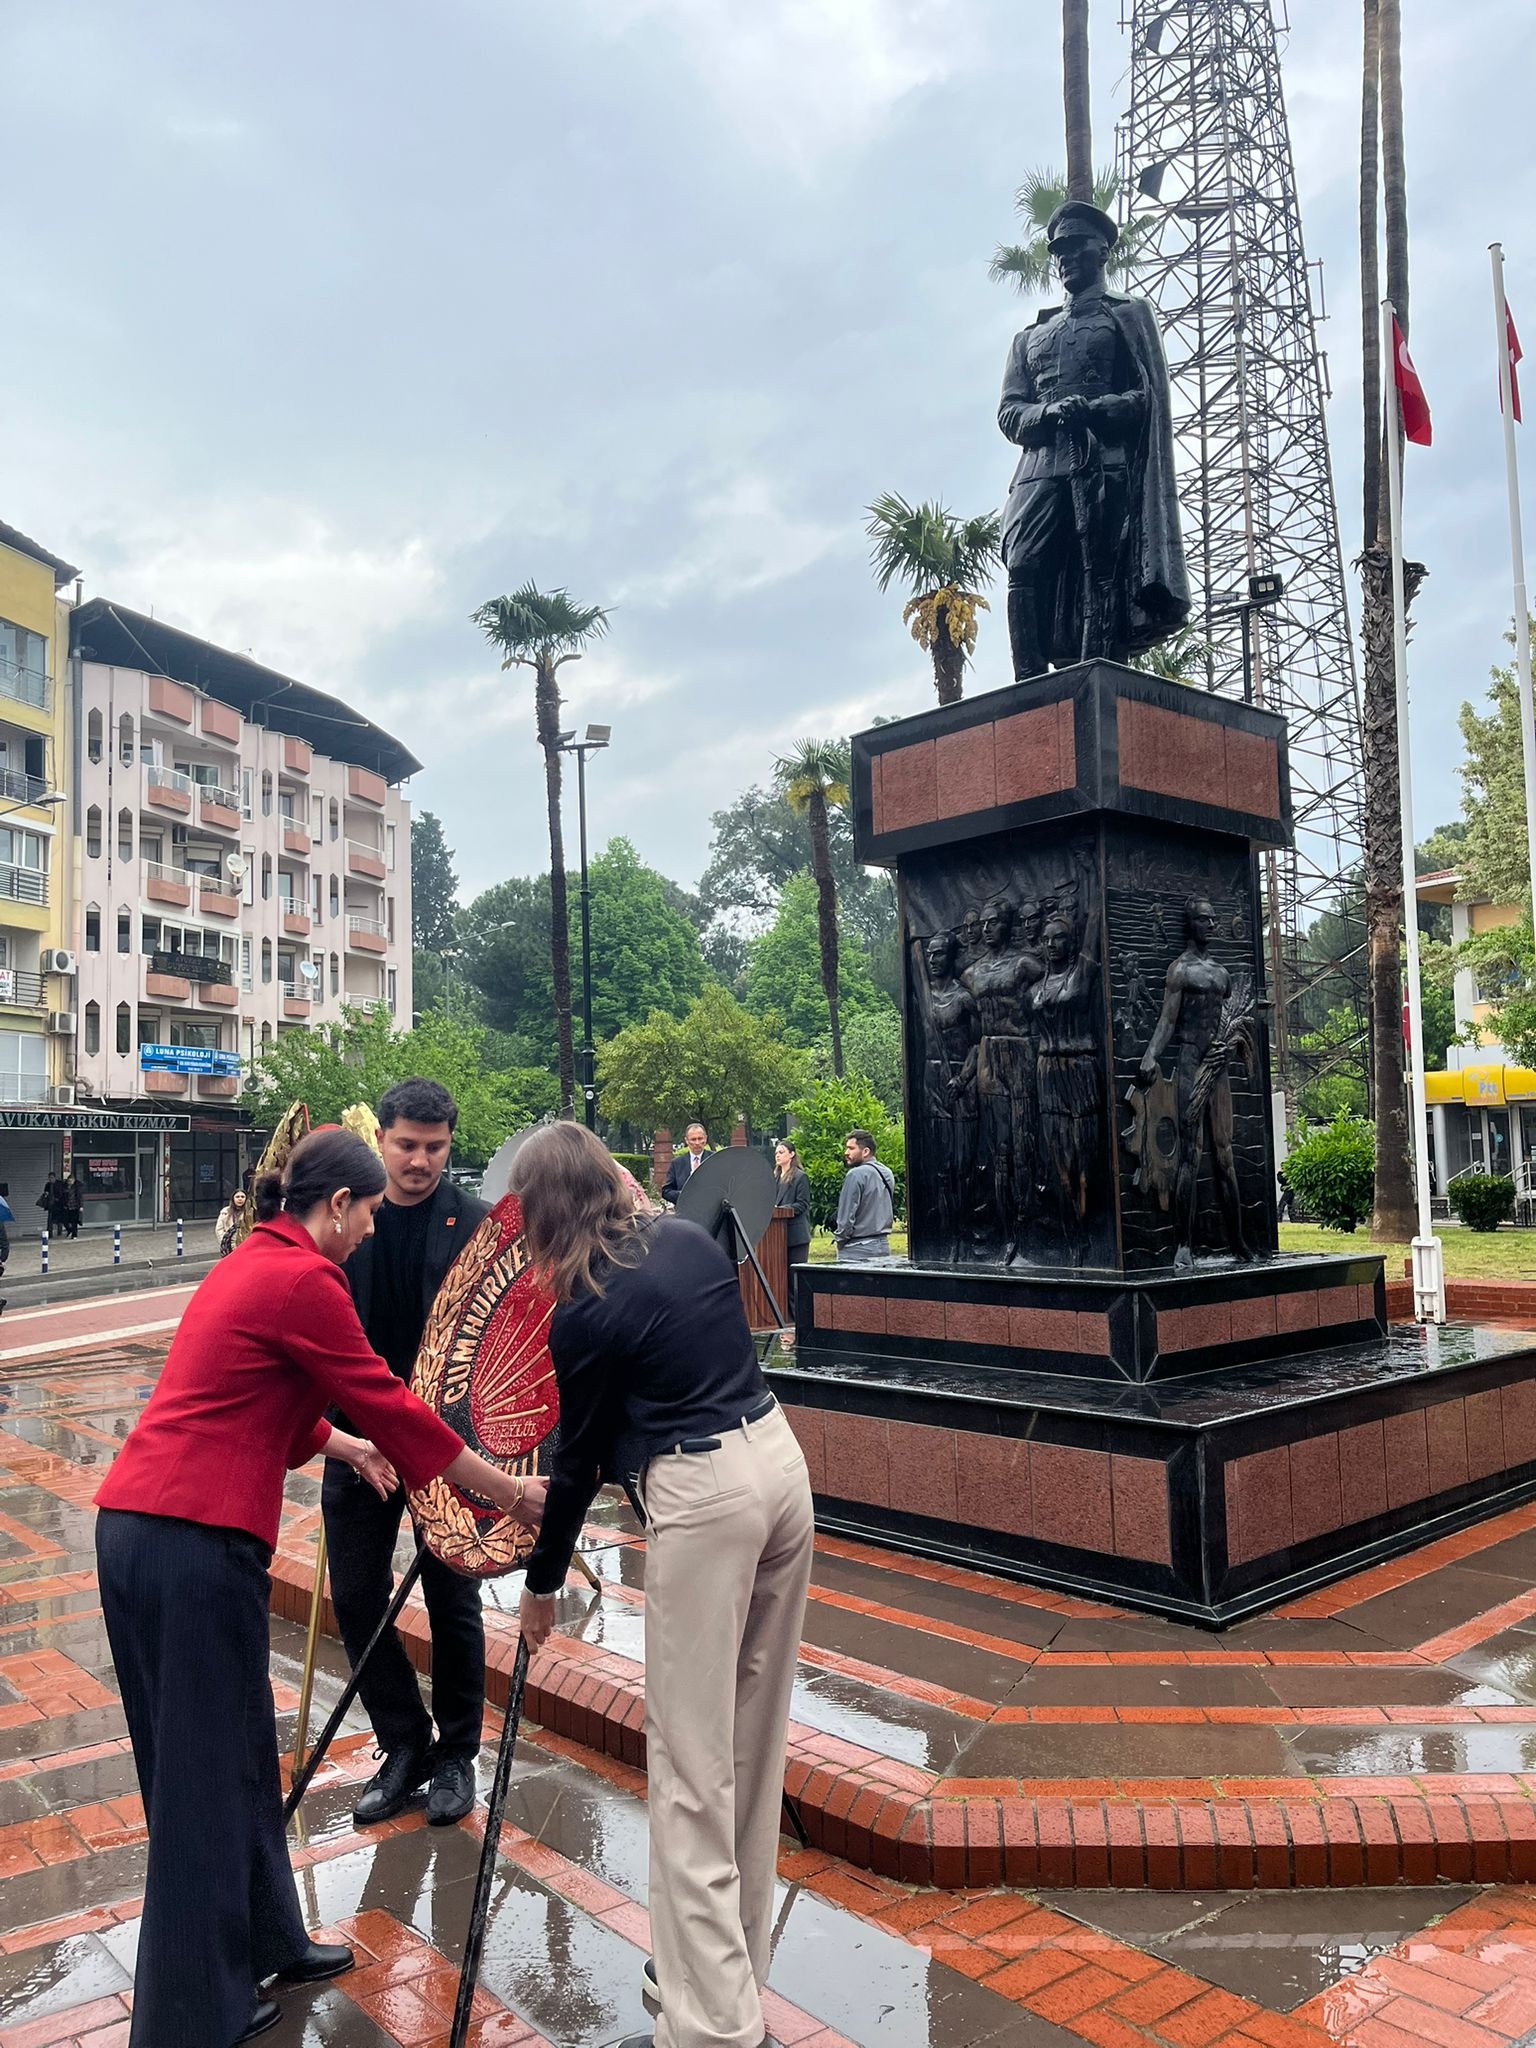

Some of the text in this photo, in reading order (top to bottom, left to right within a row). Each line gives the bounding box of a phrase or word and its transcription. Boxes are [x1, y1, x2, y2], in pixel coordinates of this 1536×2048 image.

[155, 1047, 175, 1056] LUNA
[176, 1048, 211, 1059] PSİKOLOJİ
[1479, 1081, 1498, 1094] Ptt
[122, 1116, 177, 1130] KIZMAZ
[500, 1420, 537, 1438] EYLÜL
[496, 1441, 521, 1455] 1923
